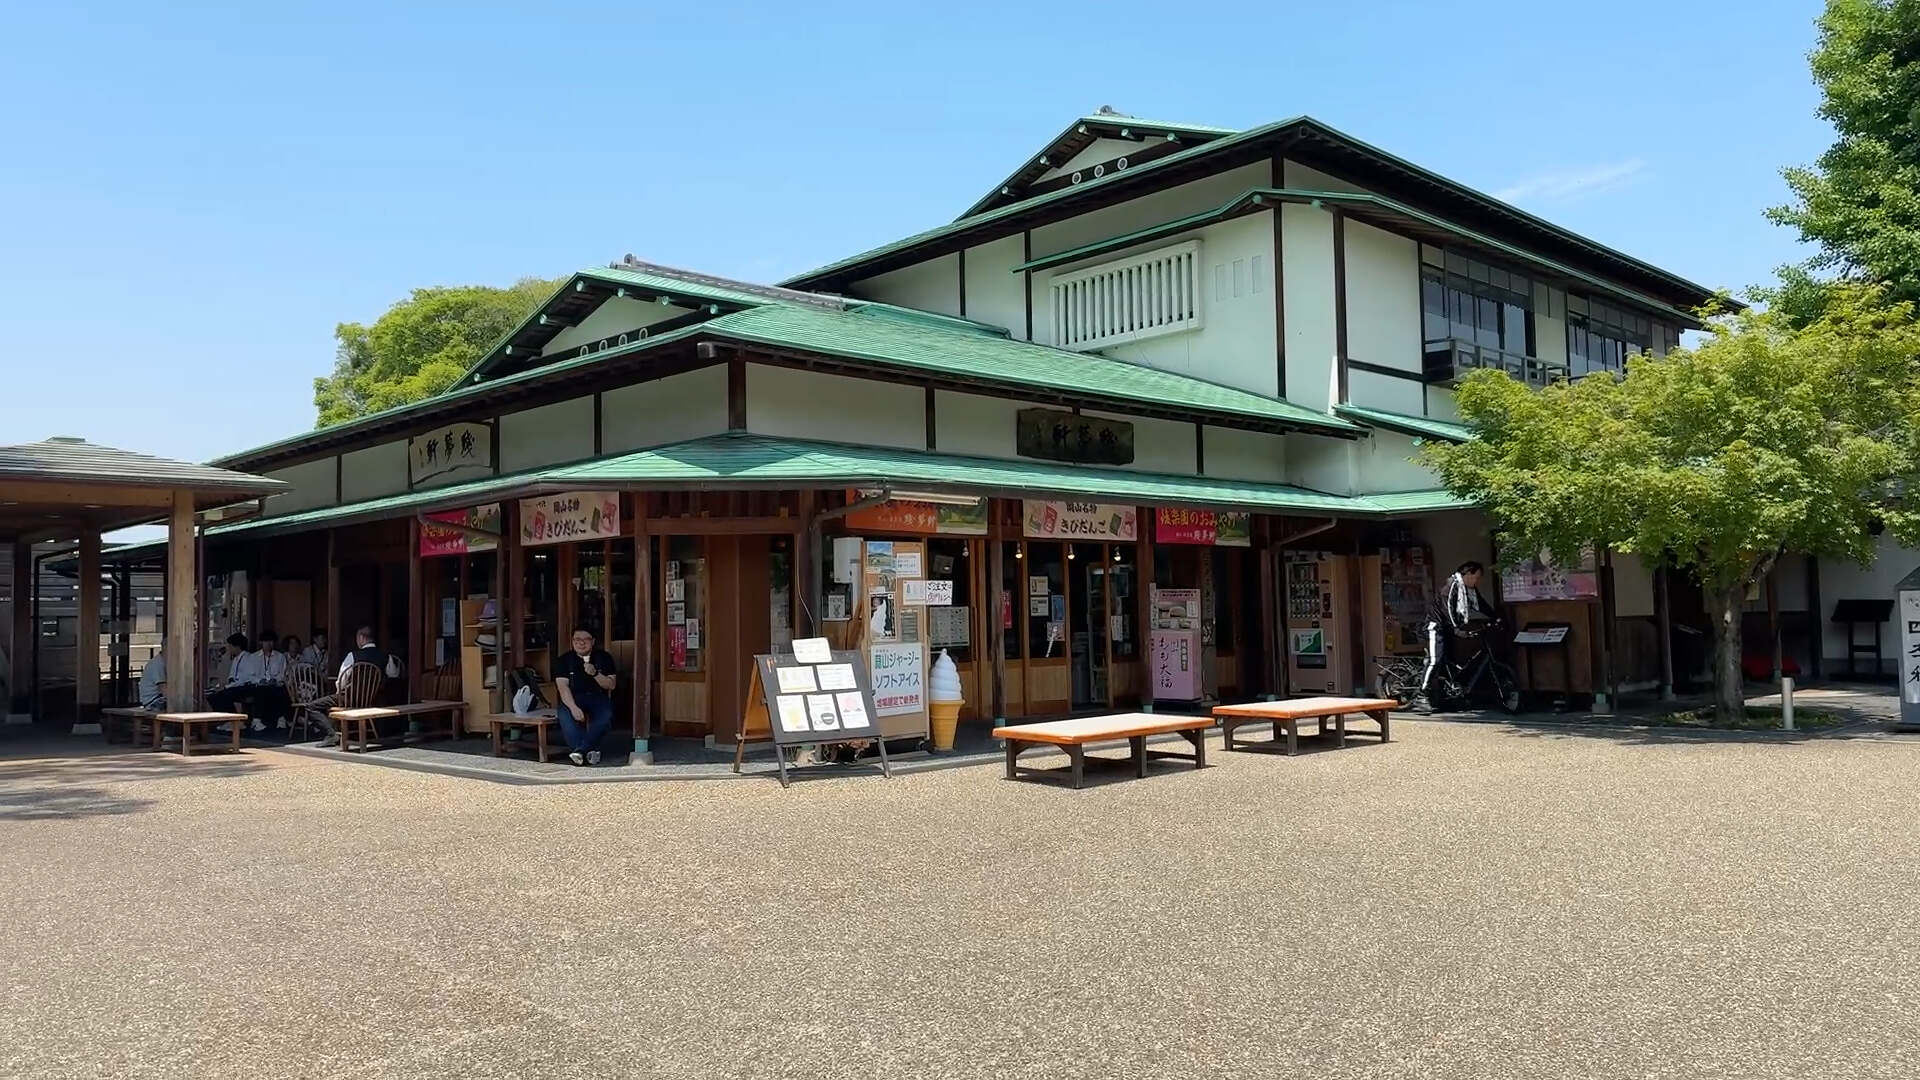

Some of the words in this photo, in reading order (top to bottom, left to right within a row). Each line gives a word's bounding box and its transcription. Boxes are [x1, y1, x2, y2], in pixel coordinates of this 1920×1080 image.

[546, 517, 588, 538] きびだんご
[1060, 518, 1106, 534] きびだんご
[876, 672, 920, 689] ソフトアイス
